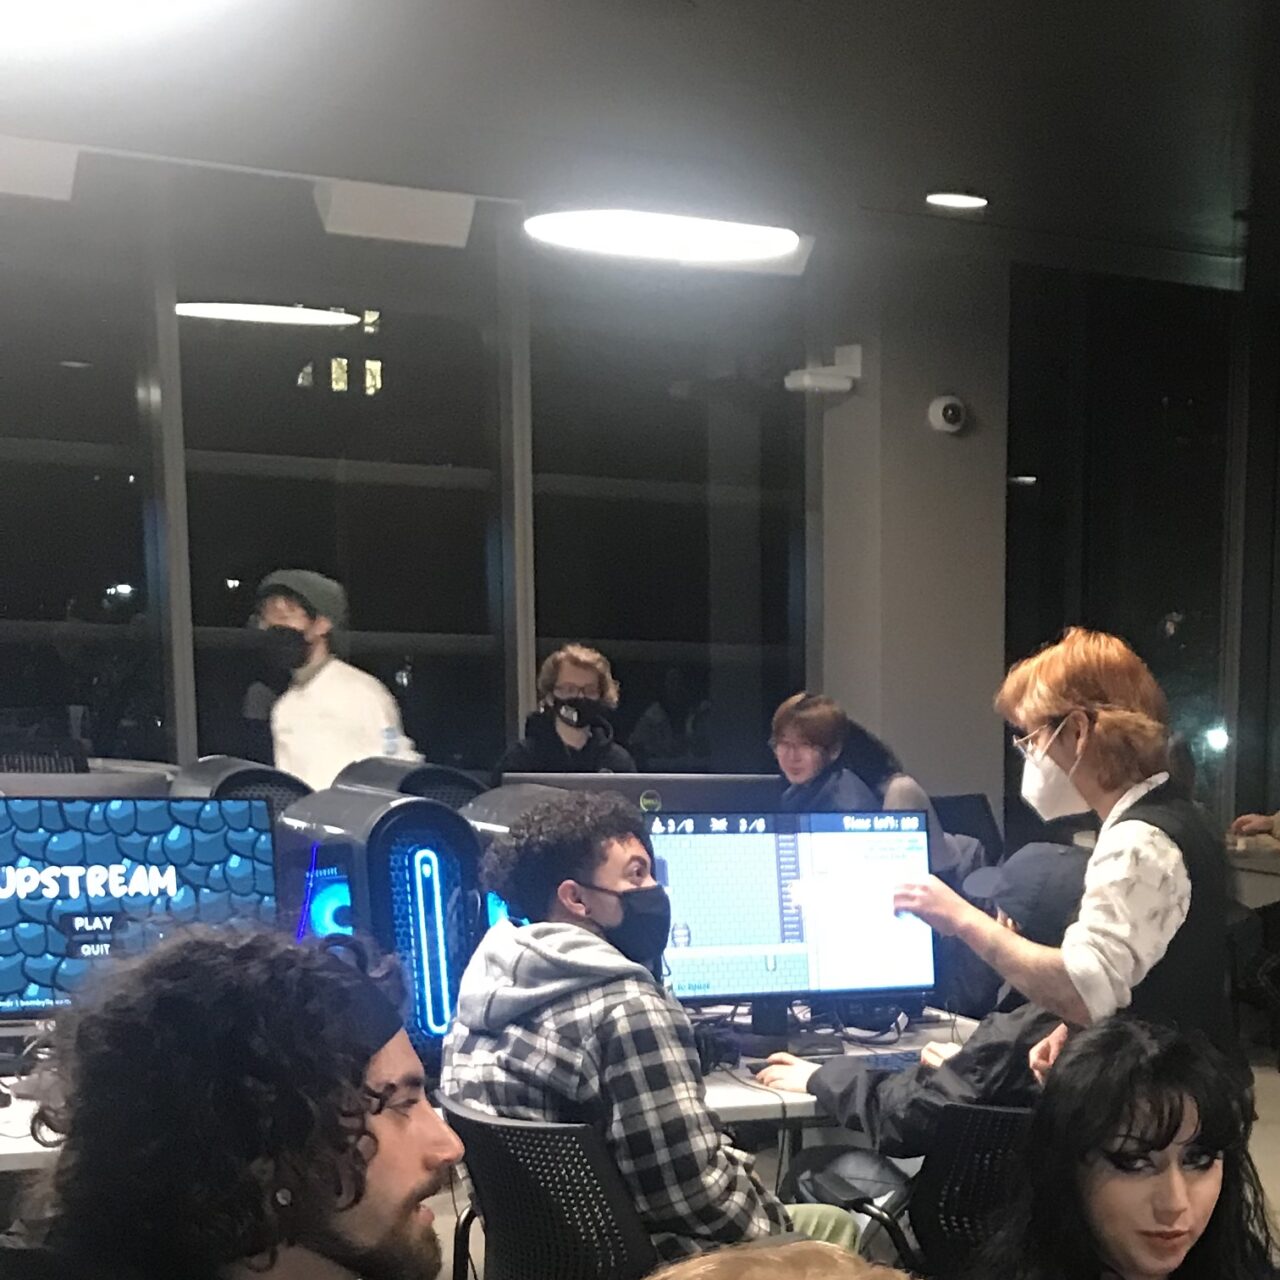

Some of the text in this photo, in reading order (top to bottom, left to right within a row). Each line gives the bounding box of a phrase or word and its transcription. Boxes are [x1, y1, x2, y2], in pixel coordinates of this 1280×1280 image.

[0, 864, 177, 899] UPSTREAM
[74, 916, 113, 931] PLAY
[80, 944, 111, 957] QUIT
